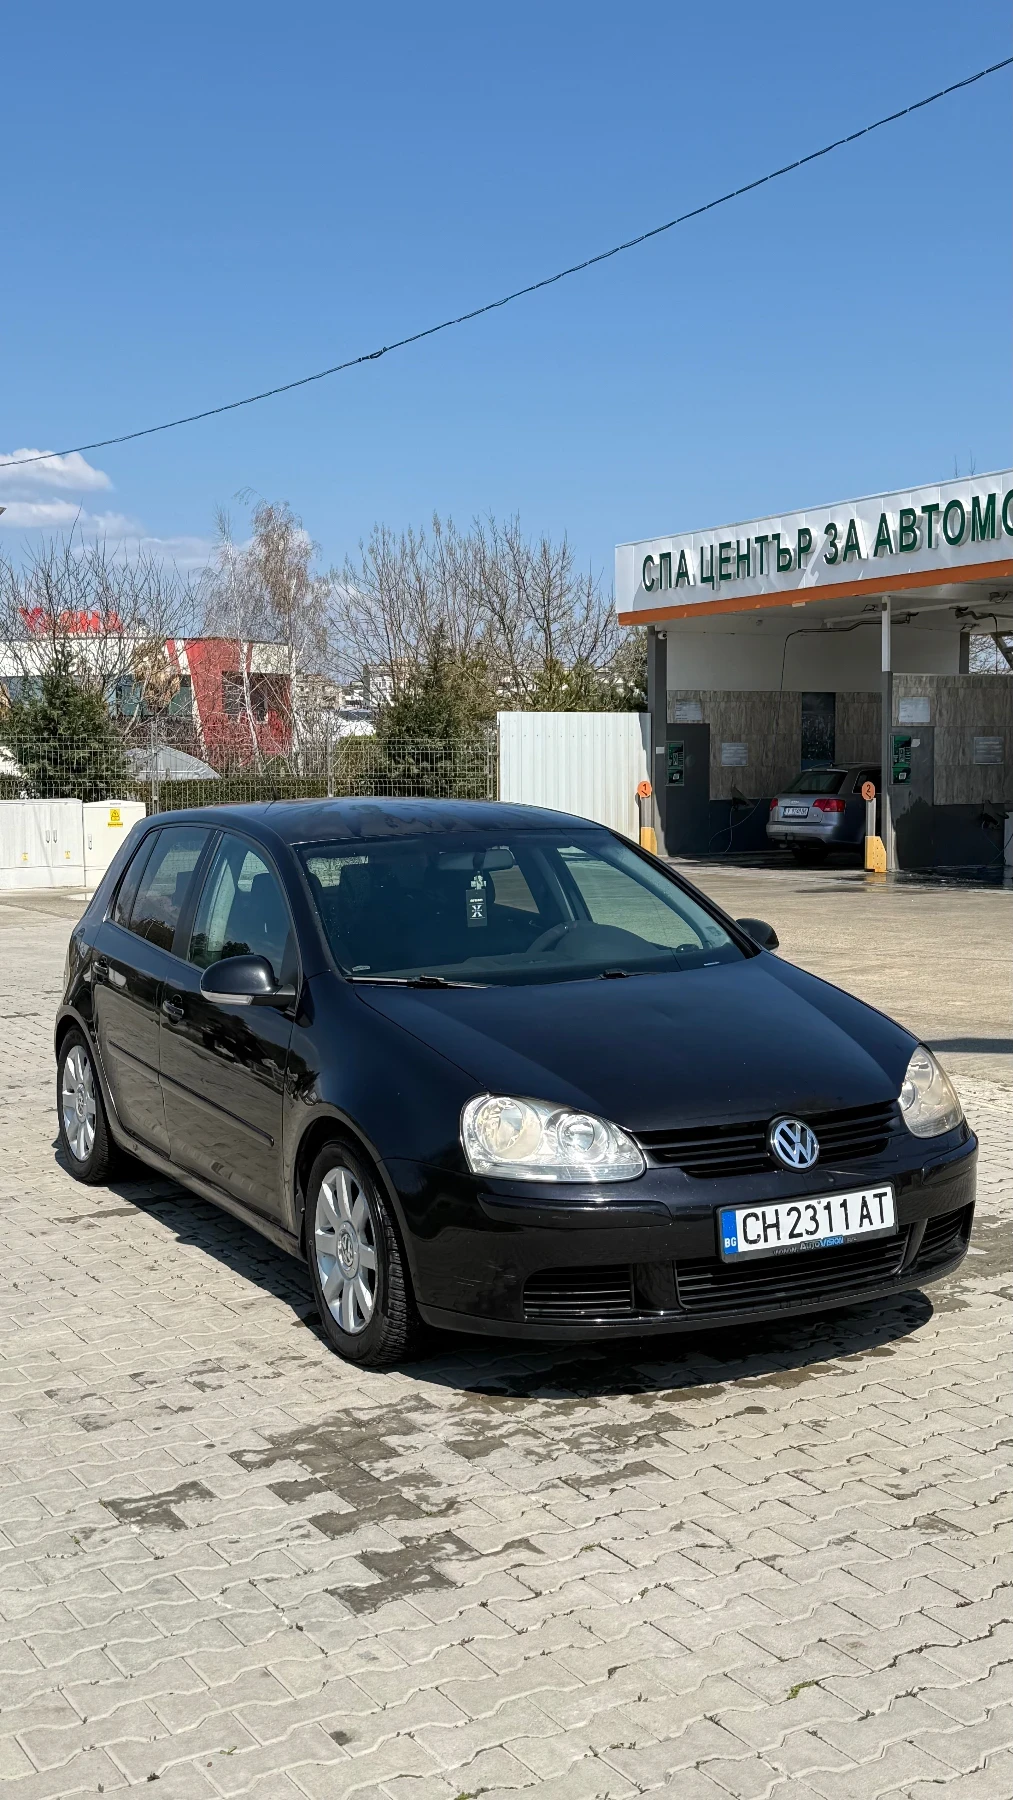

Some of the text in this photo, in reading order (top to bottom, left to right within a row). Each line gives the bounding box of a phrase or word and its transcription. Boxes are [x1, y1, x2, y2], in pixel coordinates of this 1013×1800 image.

[642, 549, 692, 592] СПА
[700, 526, 815, 591] ЦЕНТЪР
[823, 518, 864, 565] ЗА
[724, 1237, 737, 1248] BG
[742, 1192, 888, 1245] CH 2311 AT
